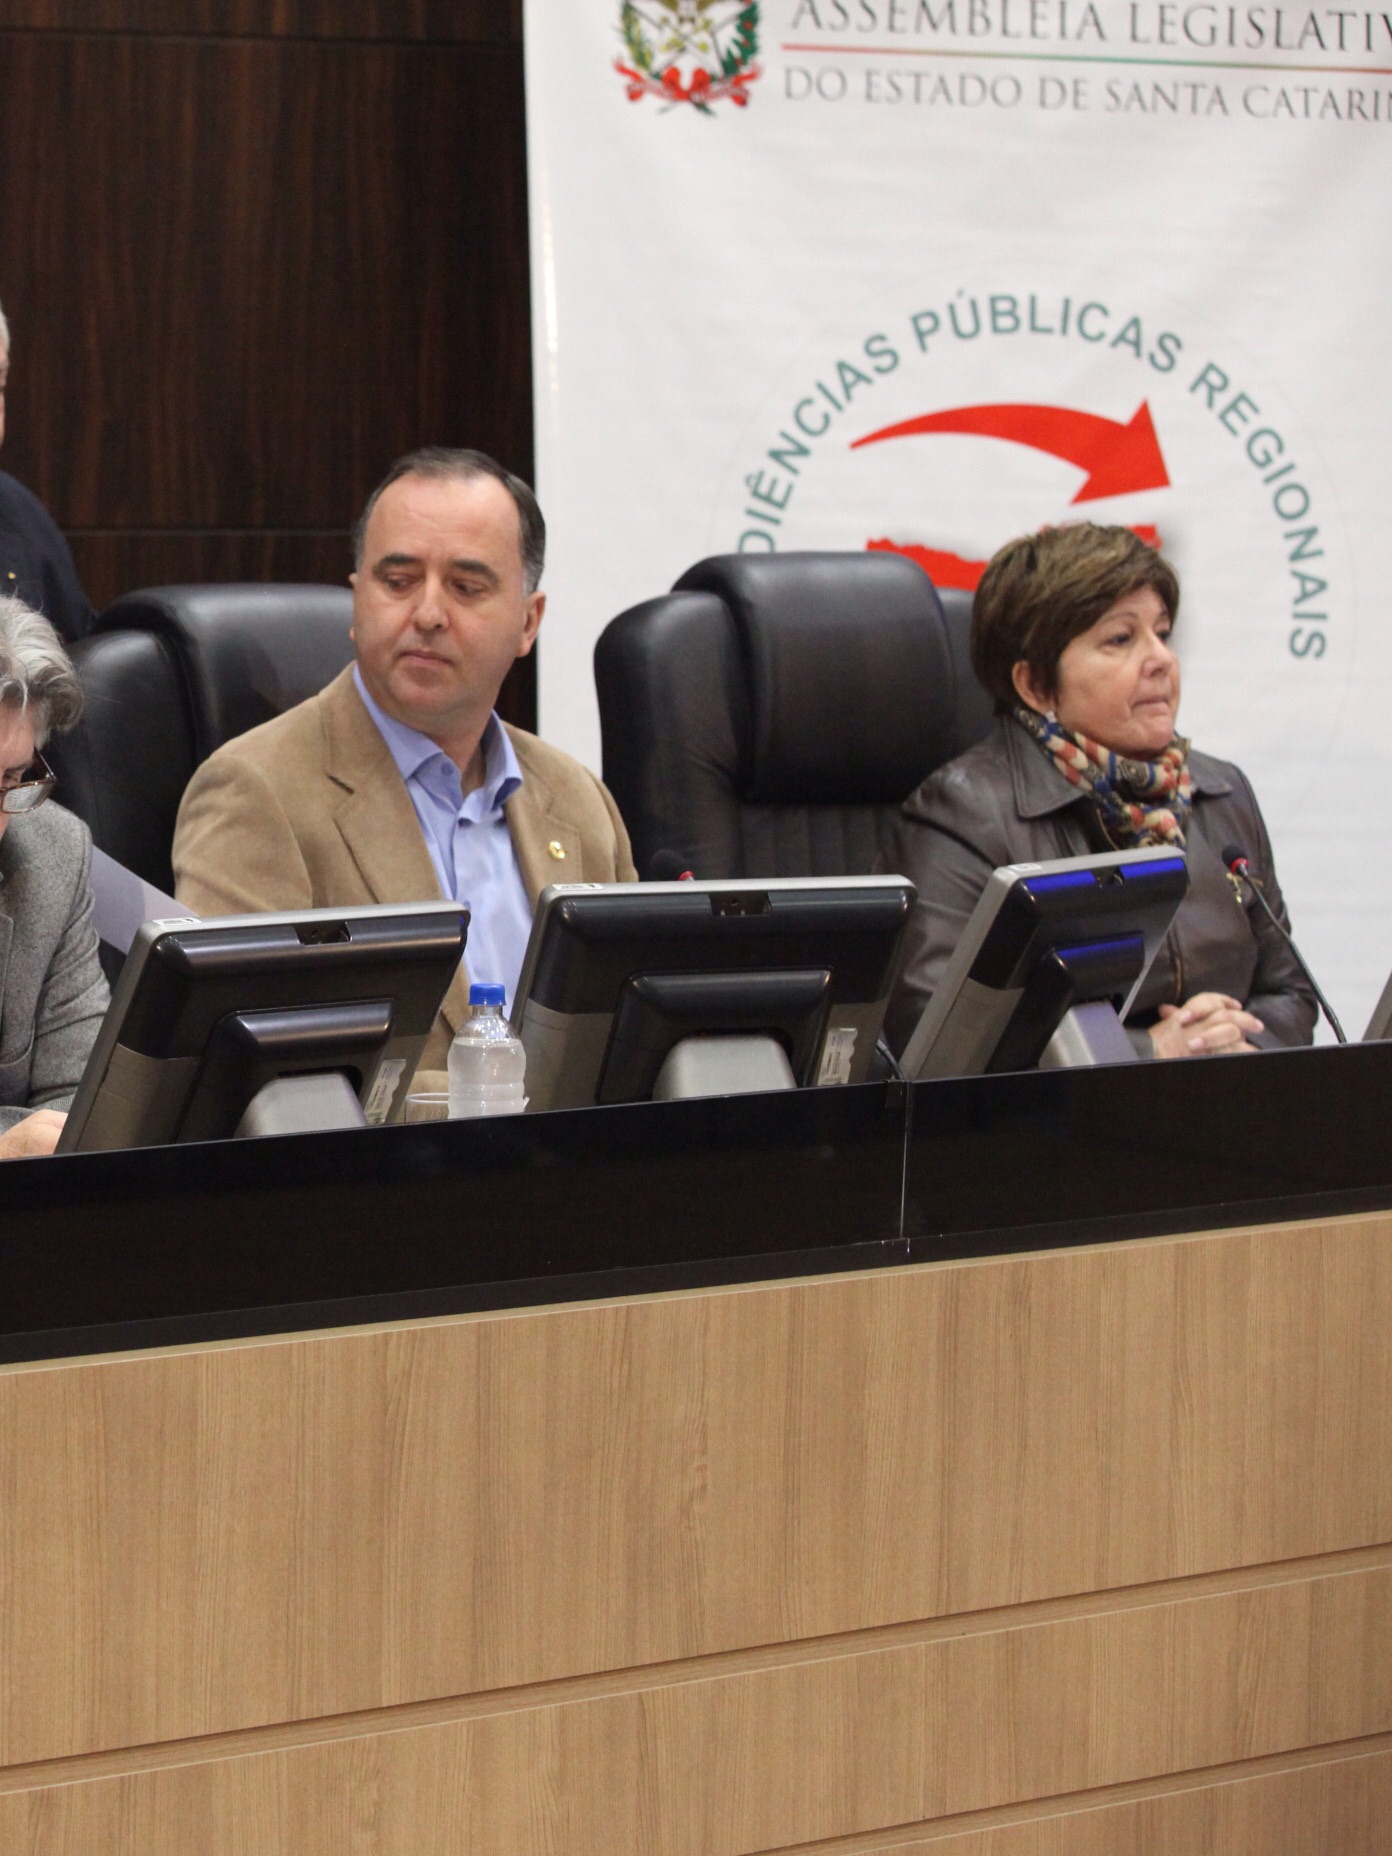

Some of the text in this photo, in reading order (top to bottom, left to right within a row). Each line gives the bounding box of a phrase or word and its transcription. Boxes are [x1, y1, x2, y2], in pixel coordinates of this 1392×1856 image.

[791, 0, 1107, 41] ASSEMBLEIA
[784, 65, 848, 102] DO
[864, 67, 1023, 108] ESTADO
[1039, 75, 1090, 111] DE
[1105, 78, 1230, 116] SANTA
[1242, 85, 1392, 122] CATARI
[737, 289, 1329, 660] DIÊNCIAS PÚBLICAS REGIONAIS
